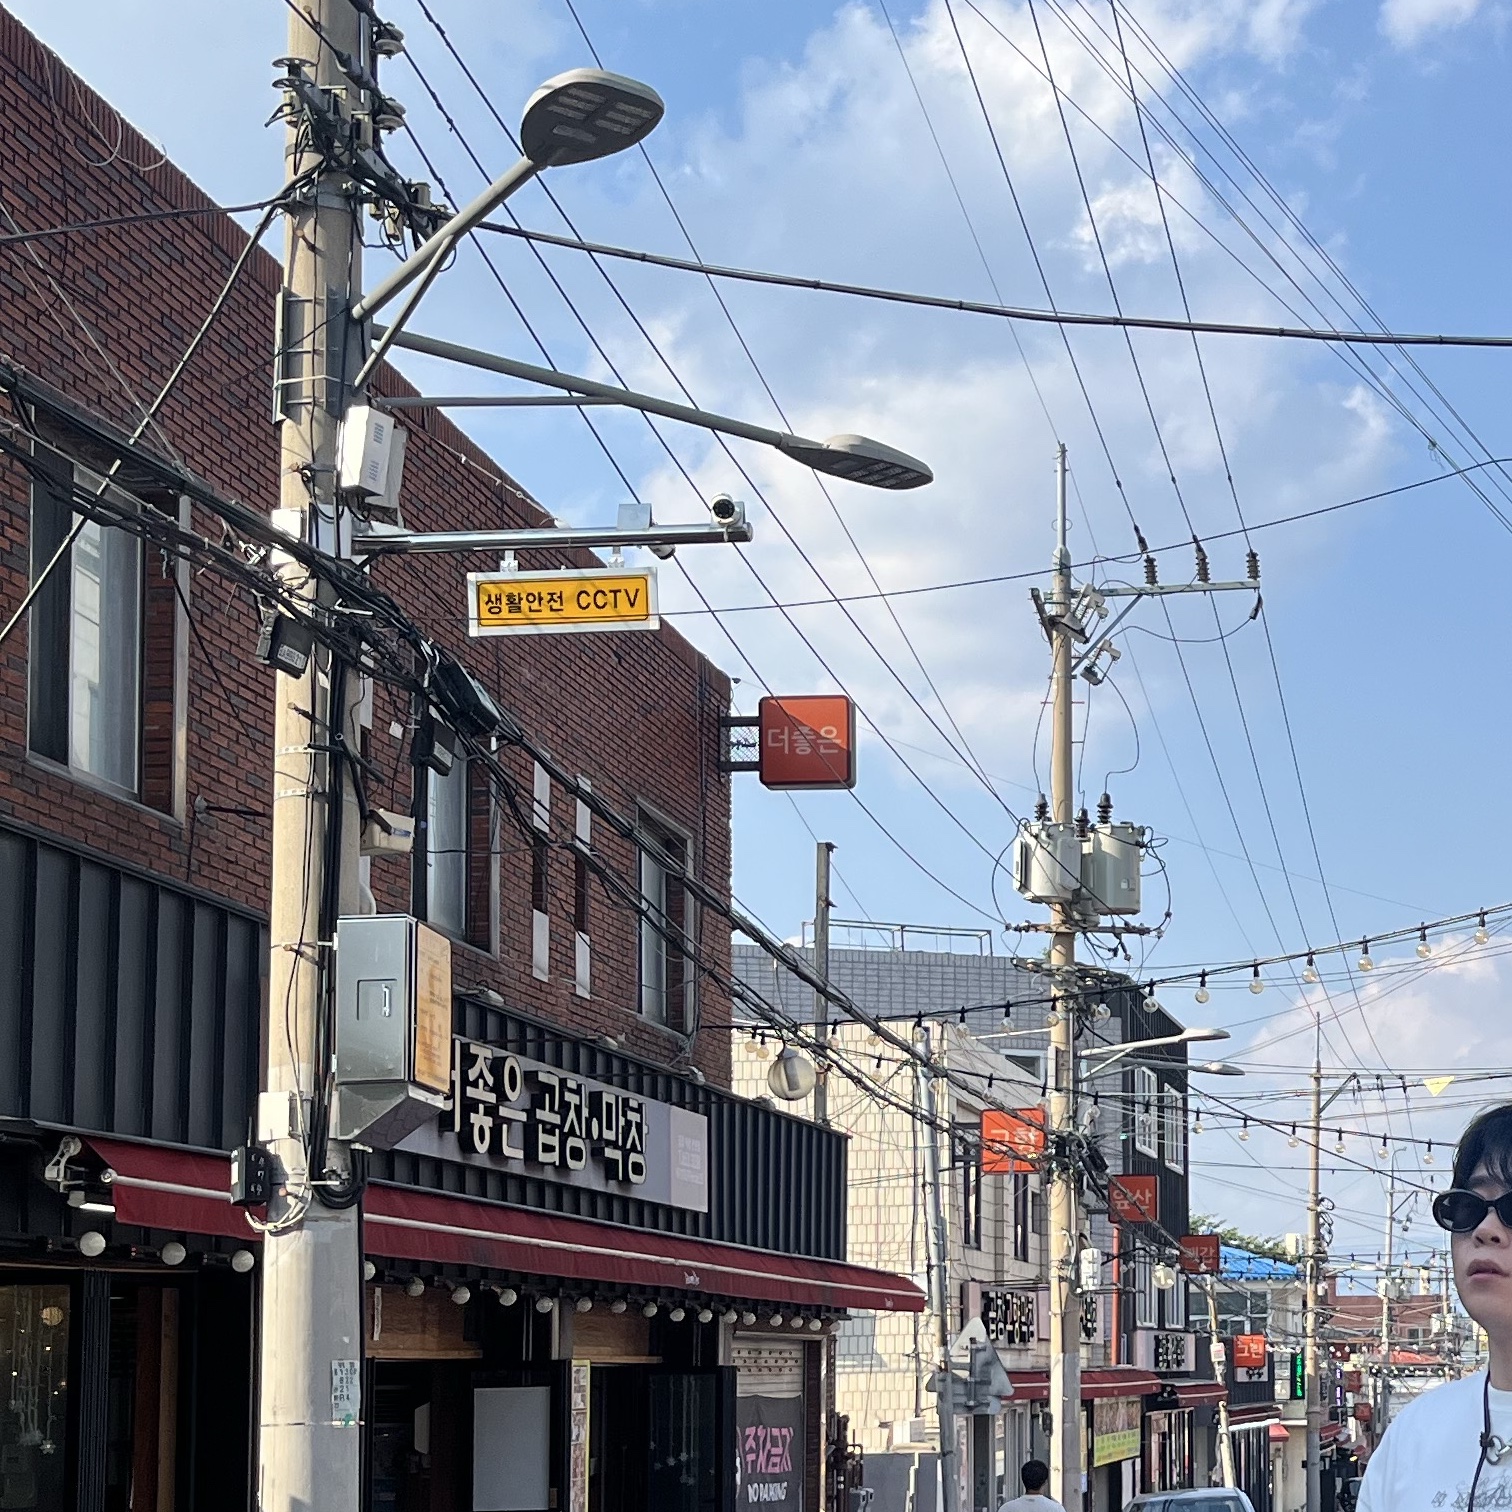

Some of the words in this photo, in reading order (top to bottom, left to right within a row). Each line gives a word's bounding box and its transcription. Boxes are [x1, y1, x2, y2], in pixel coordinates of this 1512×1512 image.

[484, 590, 565, 615] 생활안전
[576, 588, 640, 611] CCTV
[768, 725, 842, 755] 더좋은
[745, 1425, 794, 1473] 주차금지
